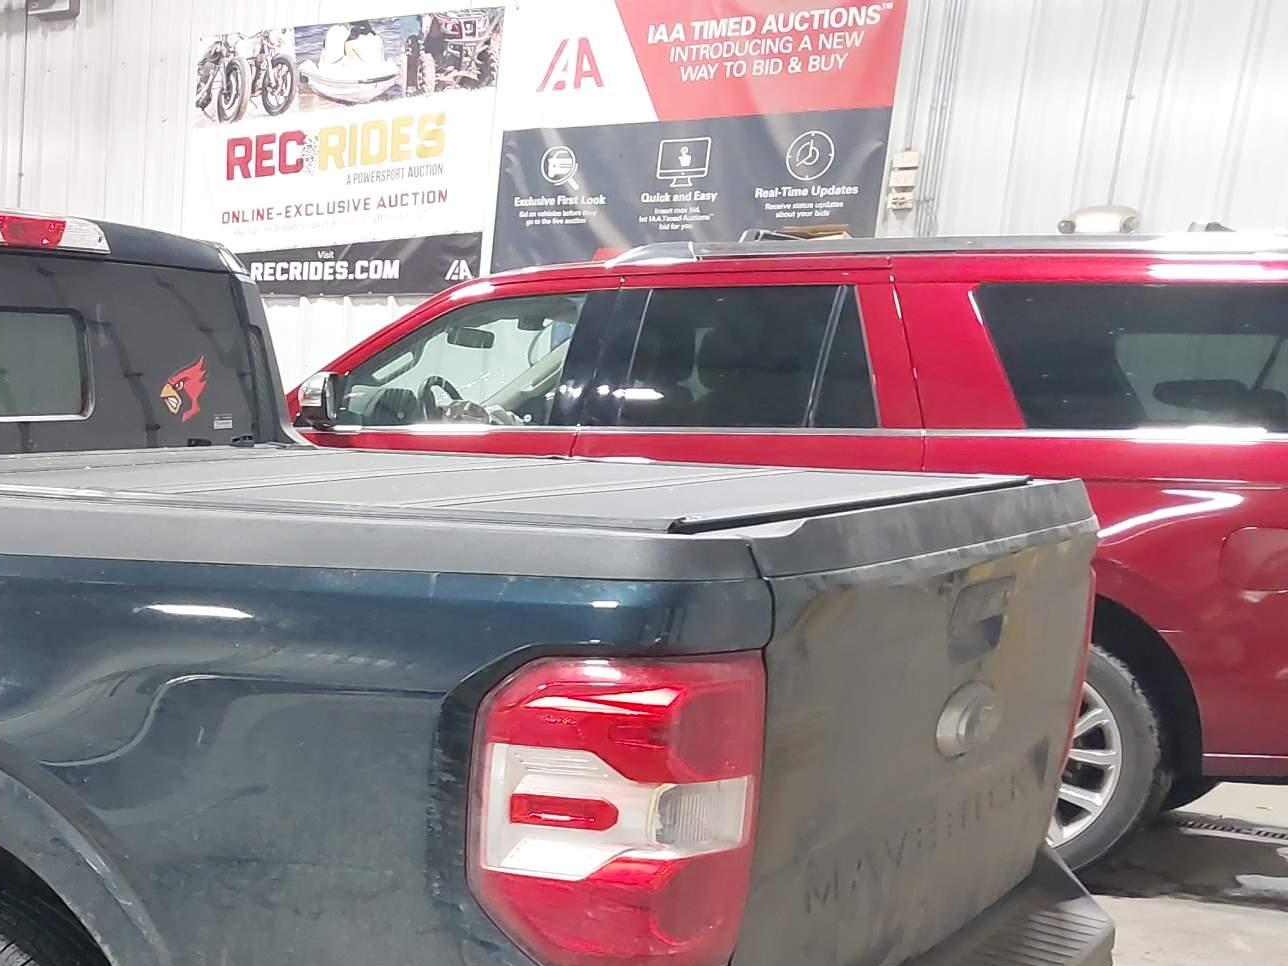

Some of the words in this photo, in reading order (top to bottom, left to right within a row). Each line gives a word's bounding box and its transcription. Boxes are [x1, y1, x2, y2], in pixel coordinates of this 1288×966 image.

[648, 23, 685, 45] IAA
[691, 15, 757, 40] TIMED
[669, 36, 793, 63] INTRODUCING
[798, 35, 813, 52] A
[818, 31, 865, 51] NEW
[680, 62, 720, 82] WAY
[723, 61, 747, 78] TO
[752, 58, 783, 76] BID
[787, 57, 802, 74] &
[808, 52, 849, 72] BUY
[226, 130, 308, 181] REC
[318, 112, 447, 172] RIDES
[352, 168, 406, 185] POWERSPORT
[407, 163, 444, 178] AUCTION
[514, 195, 555, 207] Exclusive
[557, 194, 578, 206] First
[581, 193, 606, 205] Look
[640, 192, 671, 203] Quick
[672, 191, 692, 202] and
[694, 190, 718, 203] Easy
[754, 186, 809, 198] Real-Time
[811, 185, 859, 198] Updates
[221, 197, 372, 225] ONLINE-EXCLUSIVE
[377, 189, 448, 209] AUCTION
[317, 250, 335, 259] Visit
[250, 259, 400, 282] RECRIDES.COM
